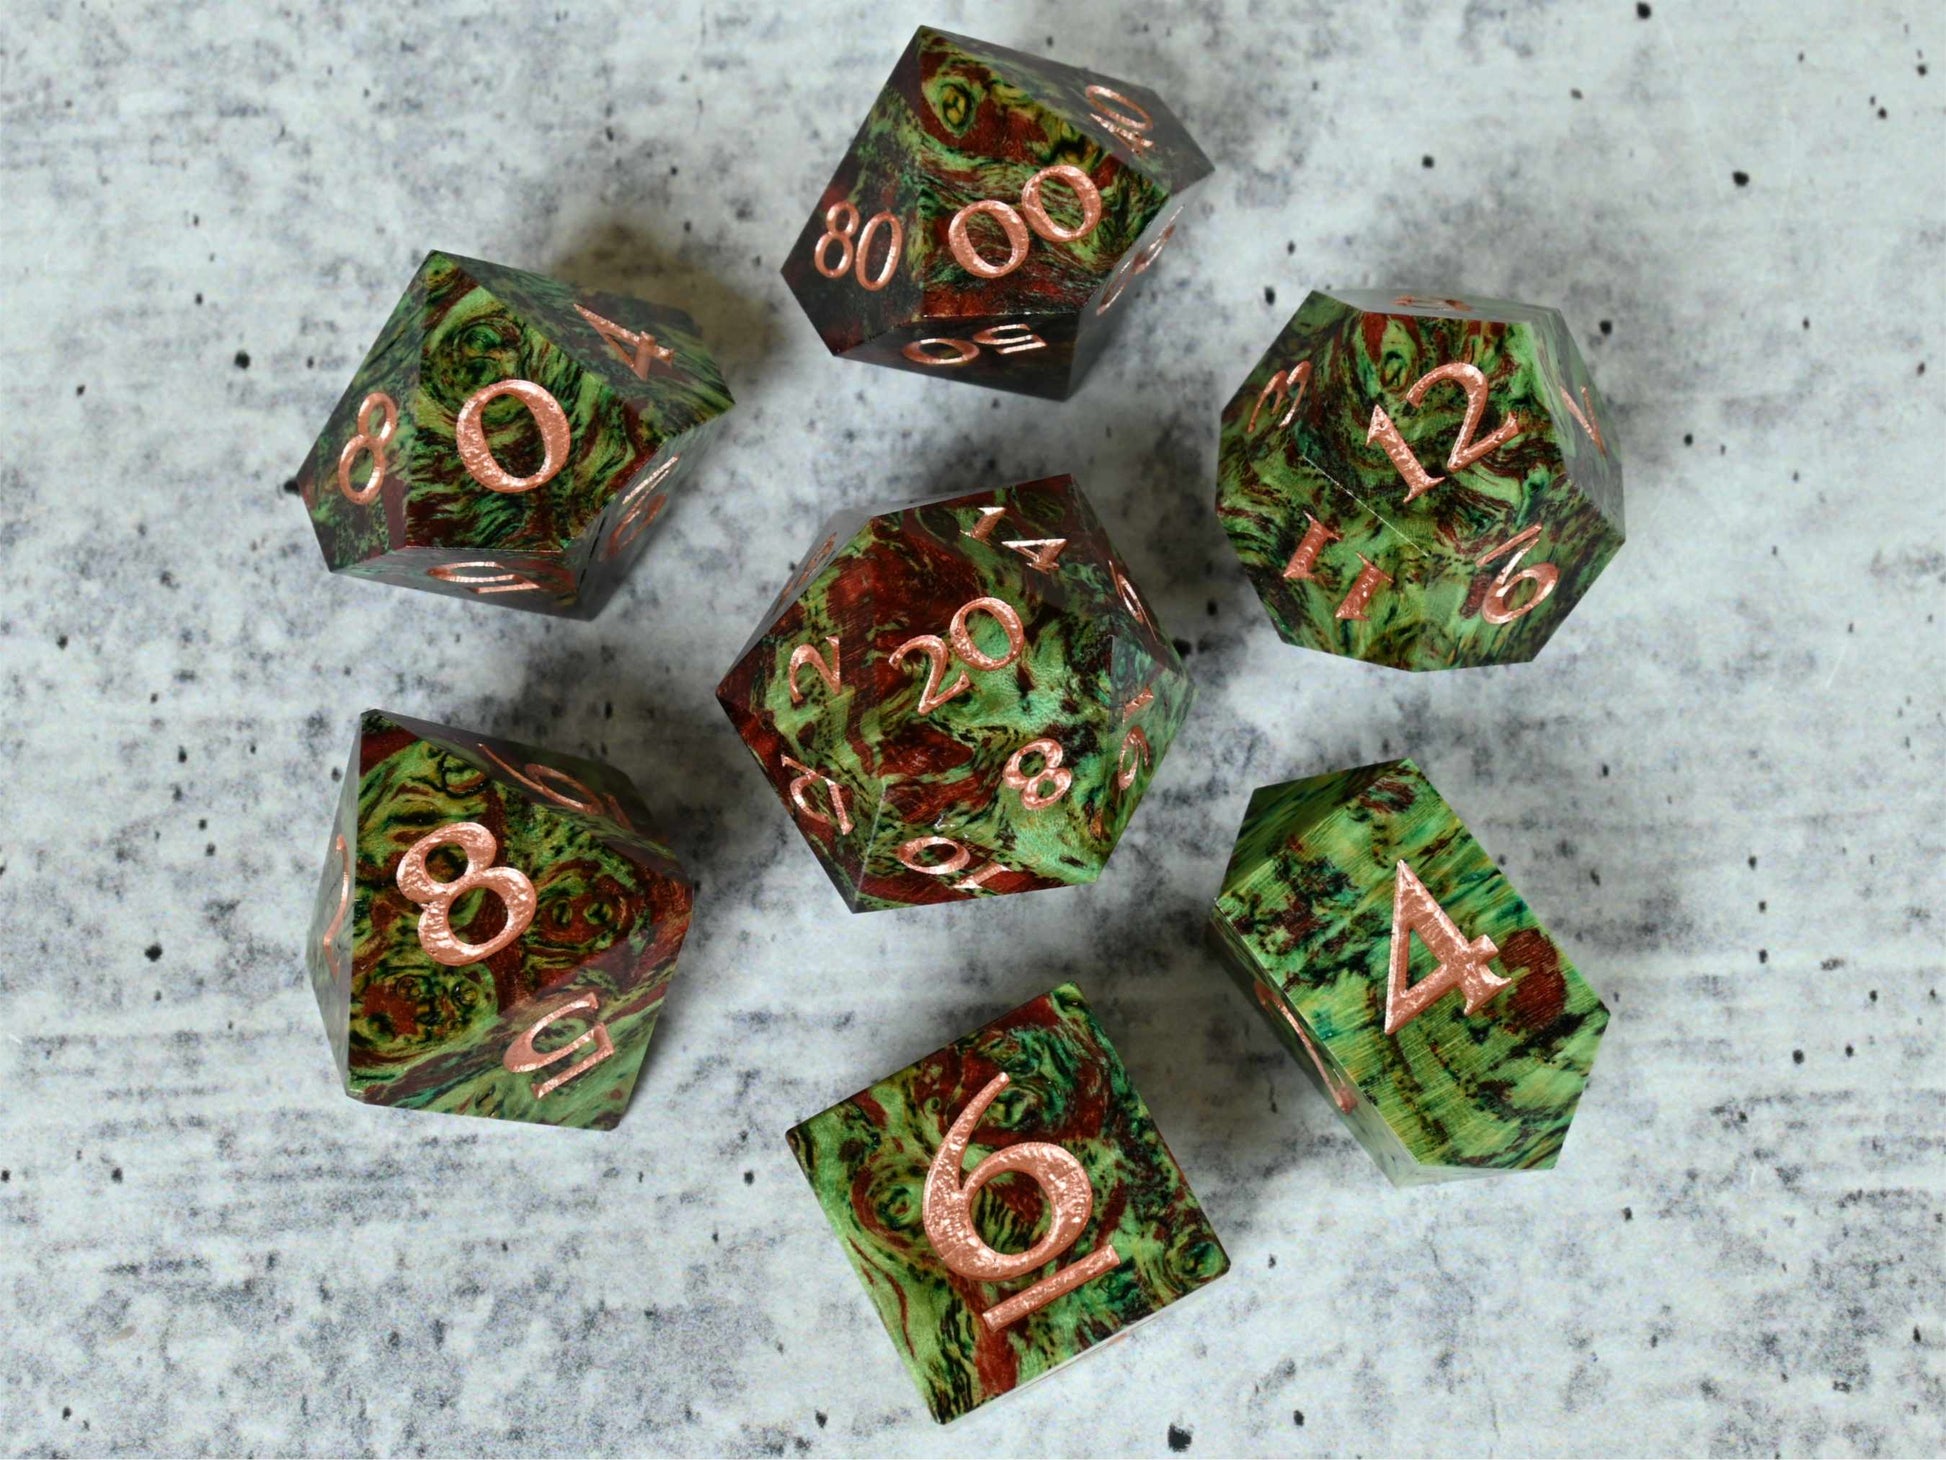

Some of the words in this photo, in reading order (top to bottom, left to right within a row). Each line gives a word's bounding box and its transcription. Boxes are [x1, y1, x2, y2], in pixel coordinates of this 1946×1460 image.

[814, 201, 903, 291] 80
[949, 165, 1101, 278] 00
[573, 303, 676, 381] 4
[903, 323, 1047, 365] 50
[1248, 360, 1312, 433] 3
[339, 392, 397, 505] 8
[456, 378, 571, 494] 0
[1366, 362, 1519, 503] 12
[959, 506, 1067, 574] 14
[1283, 511, 1394, 622] 11
[788, 636, 842, 702] 2
[889, 597, 1023, 714] 20
[1003, 738, 1072, 810] 8
[397, 822, 537, 967] 8
[899, 837, 1010, 889] 10
[1385, 860, 1511, 1035] 4
[503, 992, 615, 1099] 5
[923, 1071, 1121, 1333] 6
